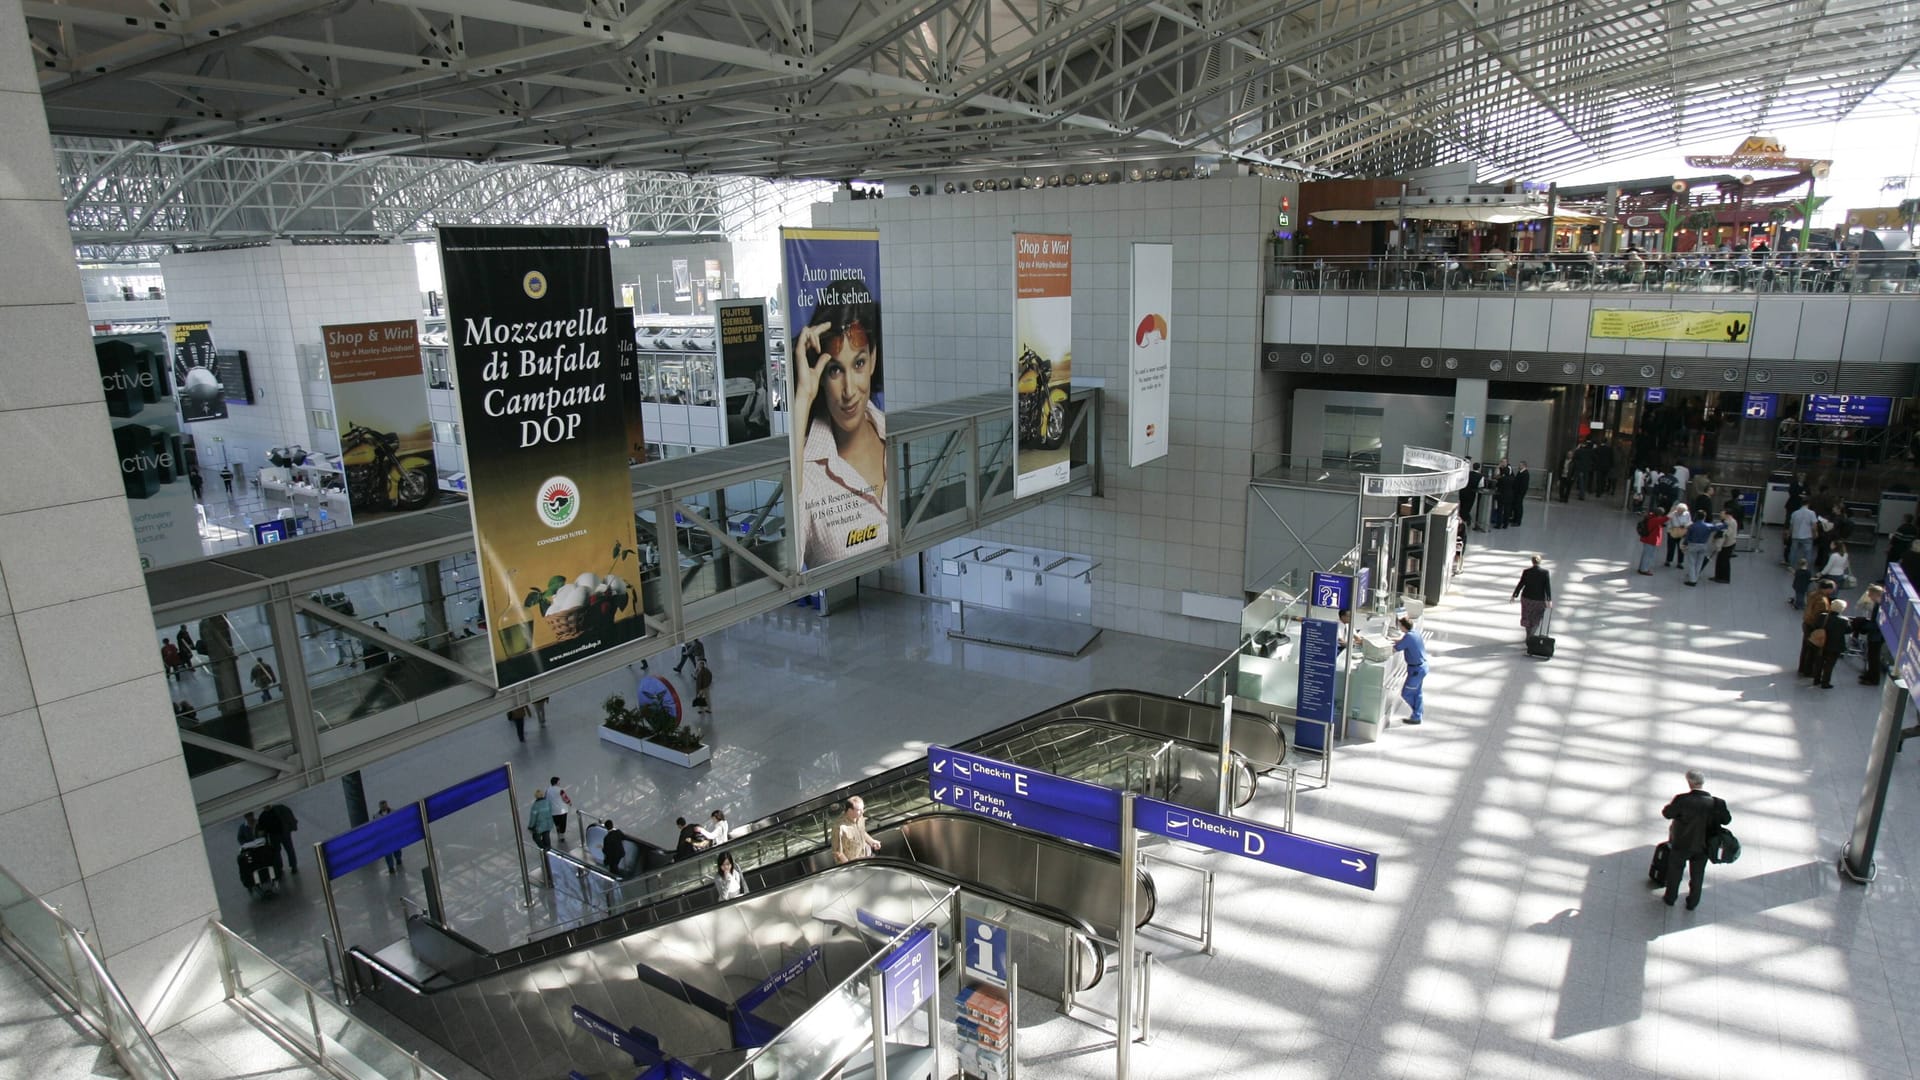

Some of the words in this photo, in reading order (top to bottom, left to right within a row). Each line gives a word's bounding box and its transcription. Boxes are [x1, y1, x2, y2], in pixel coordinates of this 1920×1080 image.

[1018, 238, 1040, 258] Shop
[1042, 240, 1048, 254] &
[1052, 240, 1069, 254] Win!
[802, 263, 828, 282] Auto
[830, 262, 866, 282] mieten,
[1018, 260, 1024, 270] Up
[798, 288, 814, 308] die
[816, 287, 840, 306] Welt
[842, 286, 872, 304] sehen.
[722, 308, 750, 318] FUJITSU
[463, 307, 608, 347] Mozzarella
[722, 316, 753, 326] SIEMENS
[328, 330, 363, 347] Shop
[368, 328, 380, 342] &
[384, 326, 414, 340] Win!
[722, 324, 764, 336] COMPUTERS
[724, 335, 742, 344] RUNS
[330, 350, 340, 358] Up
[482, 350, 510, 382] di
[518, 342, 601, 382] Bufala
[484, 382, 607, 418] Campana
[1840, 394, 1849, 403] D
[1839, 404, 1846, 412] E
[520, 413, 582, 448] DOP
[1370, 480, 1381, 488] FT
[804, 499, 820, 510] Infos
[821, 496, 827, 506] &
[846, 524, 880, 548] Hertz
[972, 762, 1011, 780] Check-in
[1014, 772, 1028, 796] E
[955, 787, 964, 800] P
[973, 790, 1005, 807] Parken
[974, 802, 990, 813] Car
[992, 806, 1013, 820] Park
[1192, 818, 1239, 838] Check-in
[1244, 831, 1265, 855] D
[912, 952, 922, 966] 60
[612, 1032, 620, 1046] E
